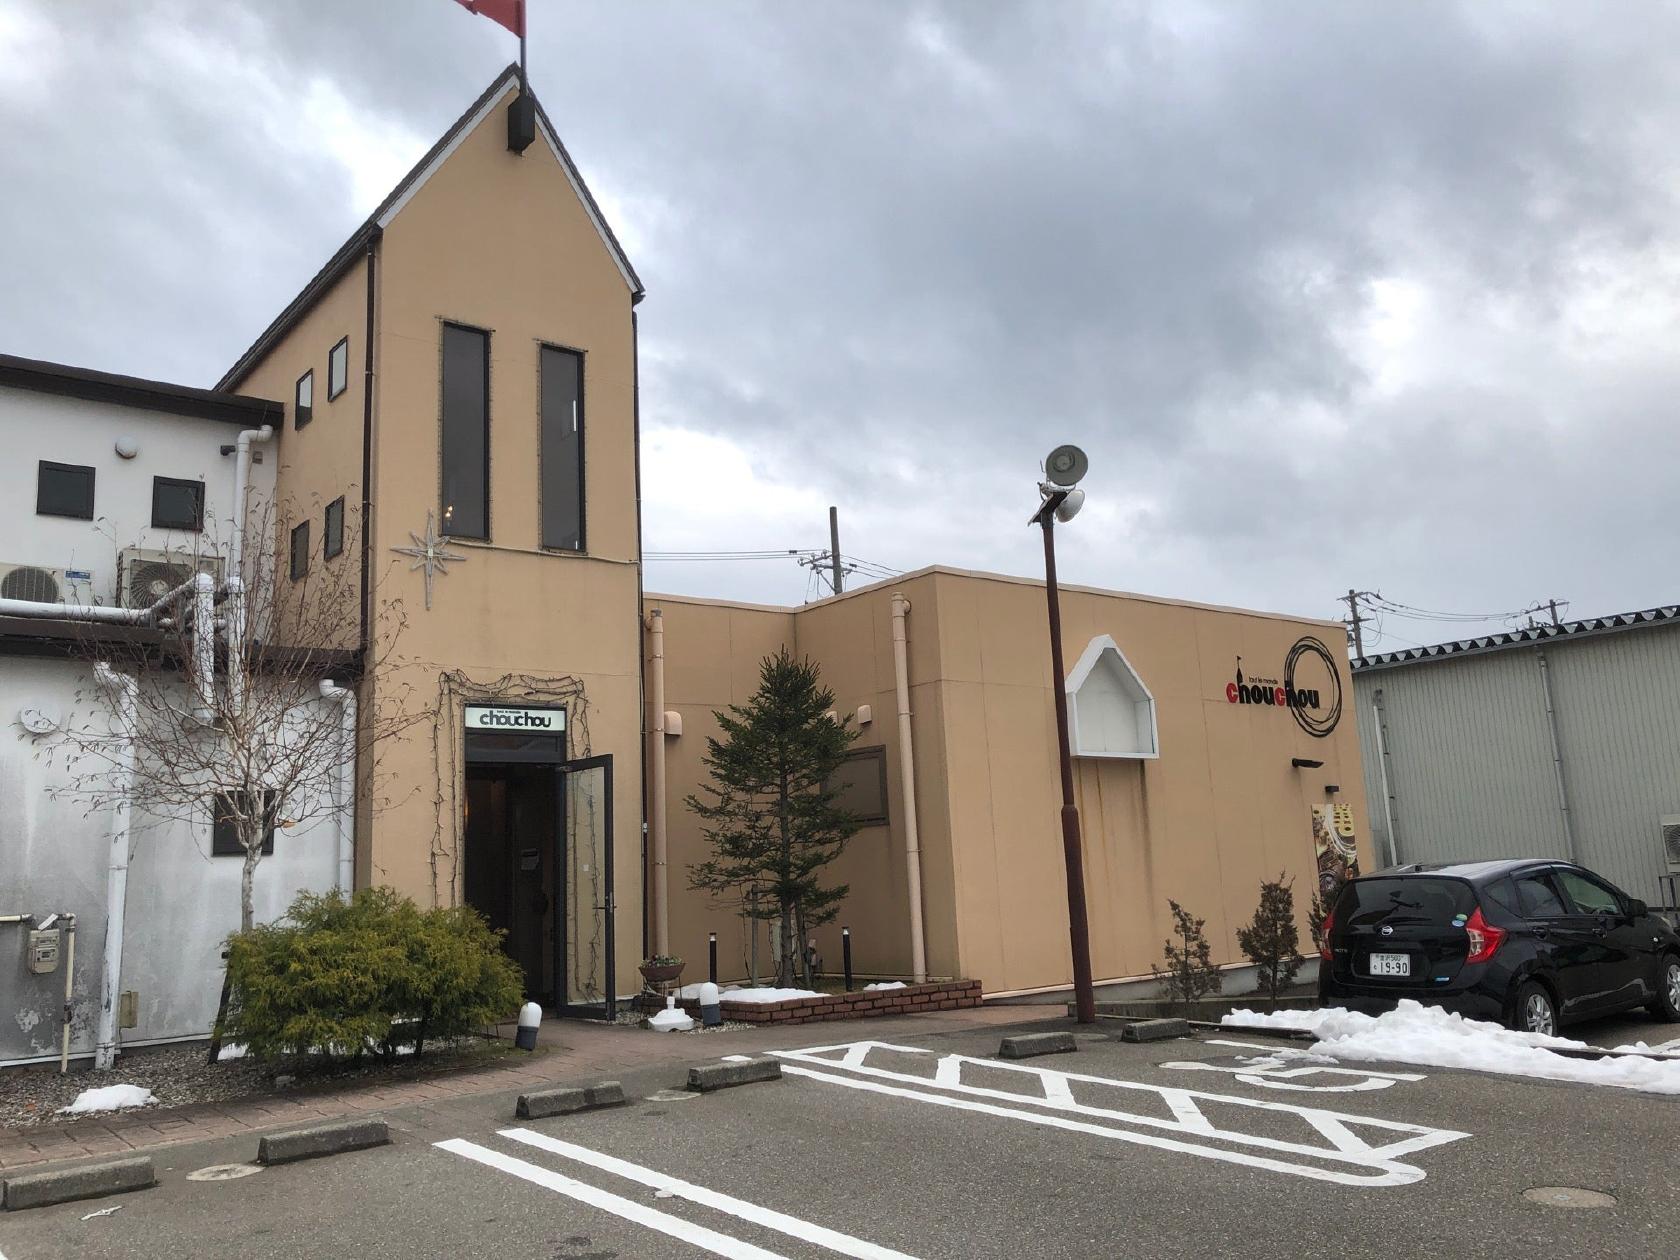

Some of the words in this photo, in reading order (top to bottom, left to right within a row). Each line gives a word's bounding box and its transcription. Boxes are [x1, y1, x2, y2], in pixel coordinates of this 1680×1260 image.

[1226, 670, 1320, 709] chouchou
[479, 710, 552, 728] chouchou
[1380, 962, 1408, 974] 19-90
